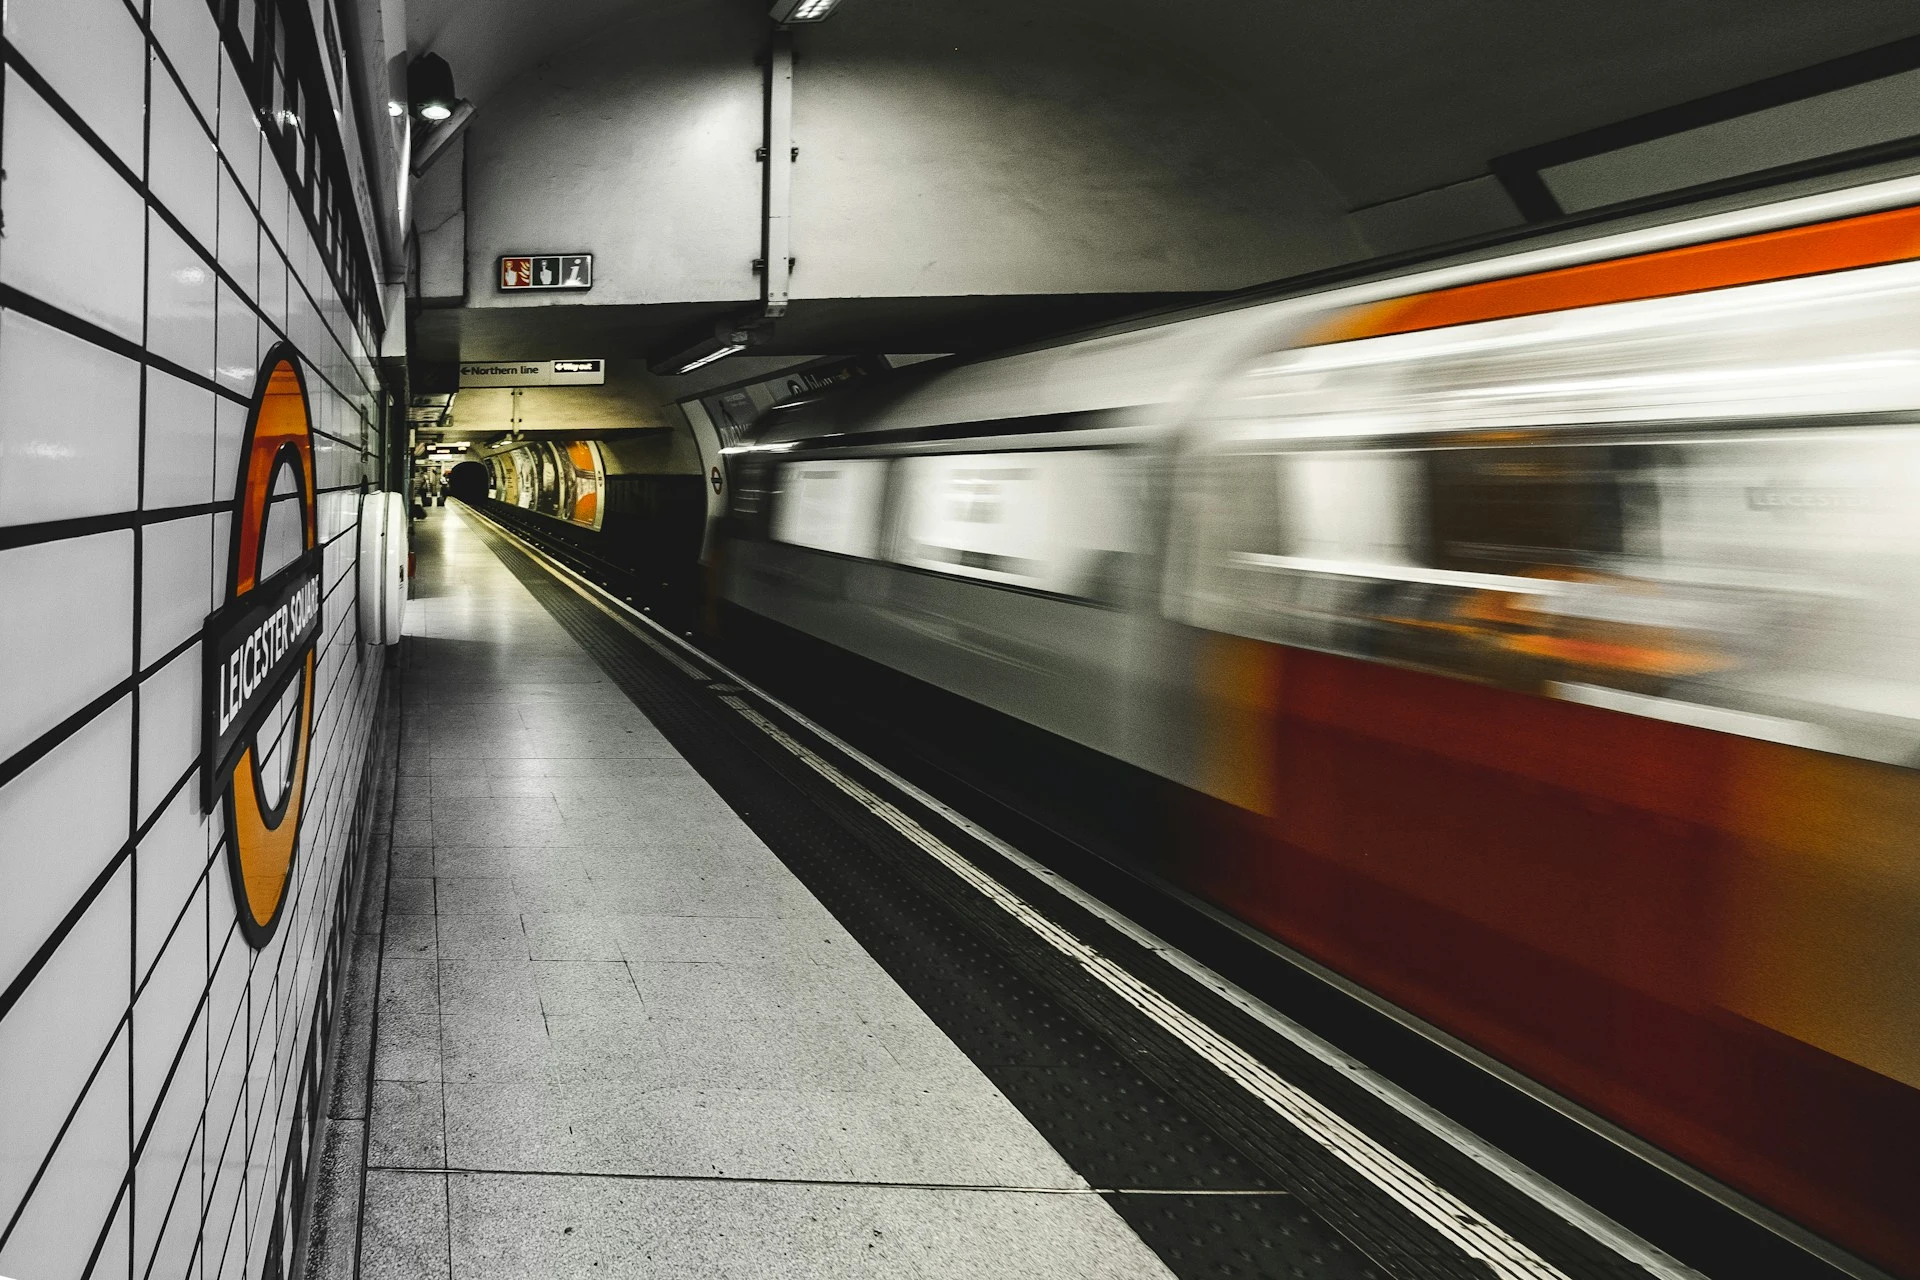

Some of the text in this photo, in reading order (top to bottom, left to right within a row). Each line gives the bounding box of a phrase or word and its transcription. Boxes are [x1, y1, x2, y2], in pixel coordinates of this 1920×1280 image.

[471, 365, 539, 375] Northern line
[219, 573, 320, 737] LEICESTER SQUARE
